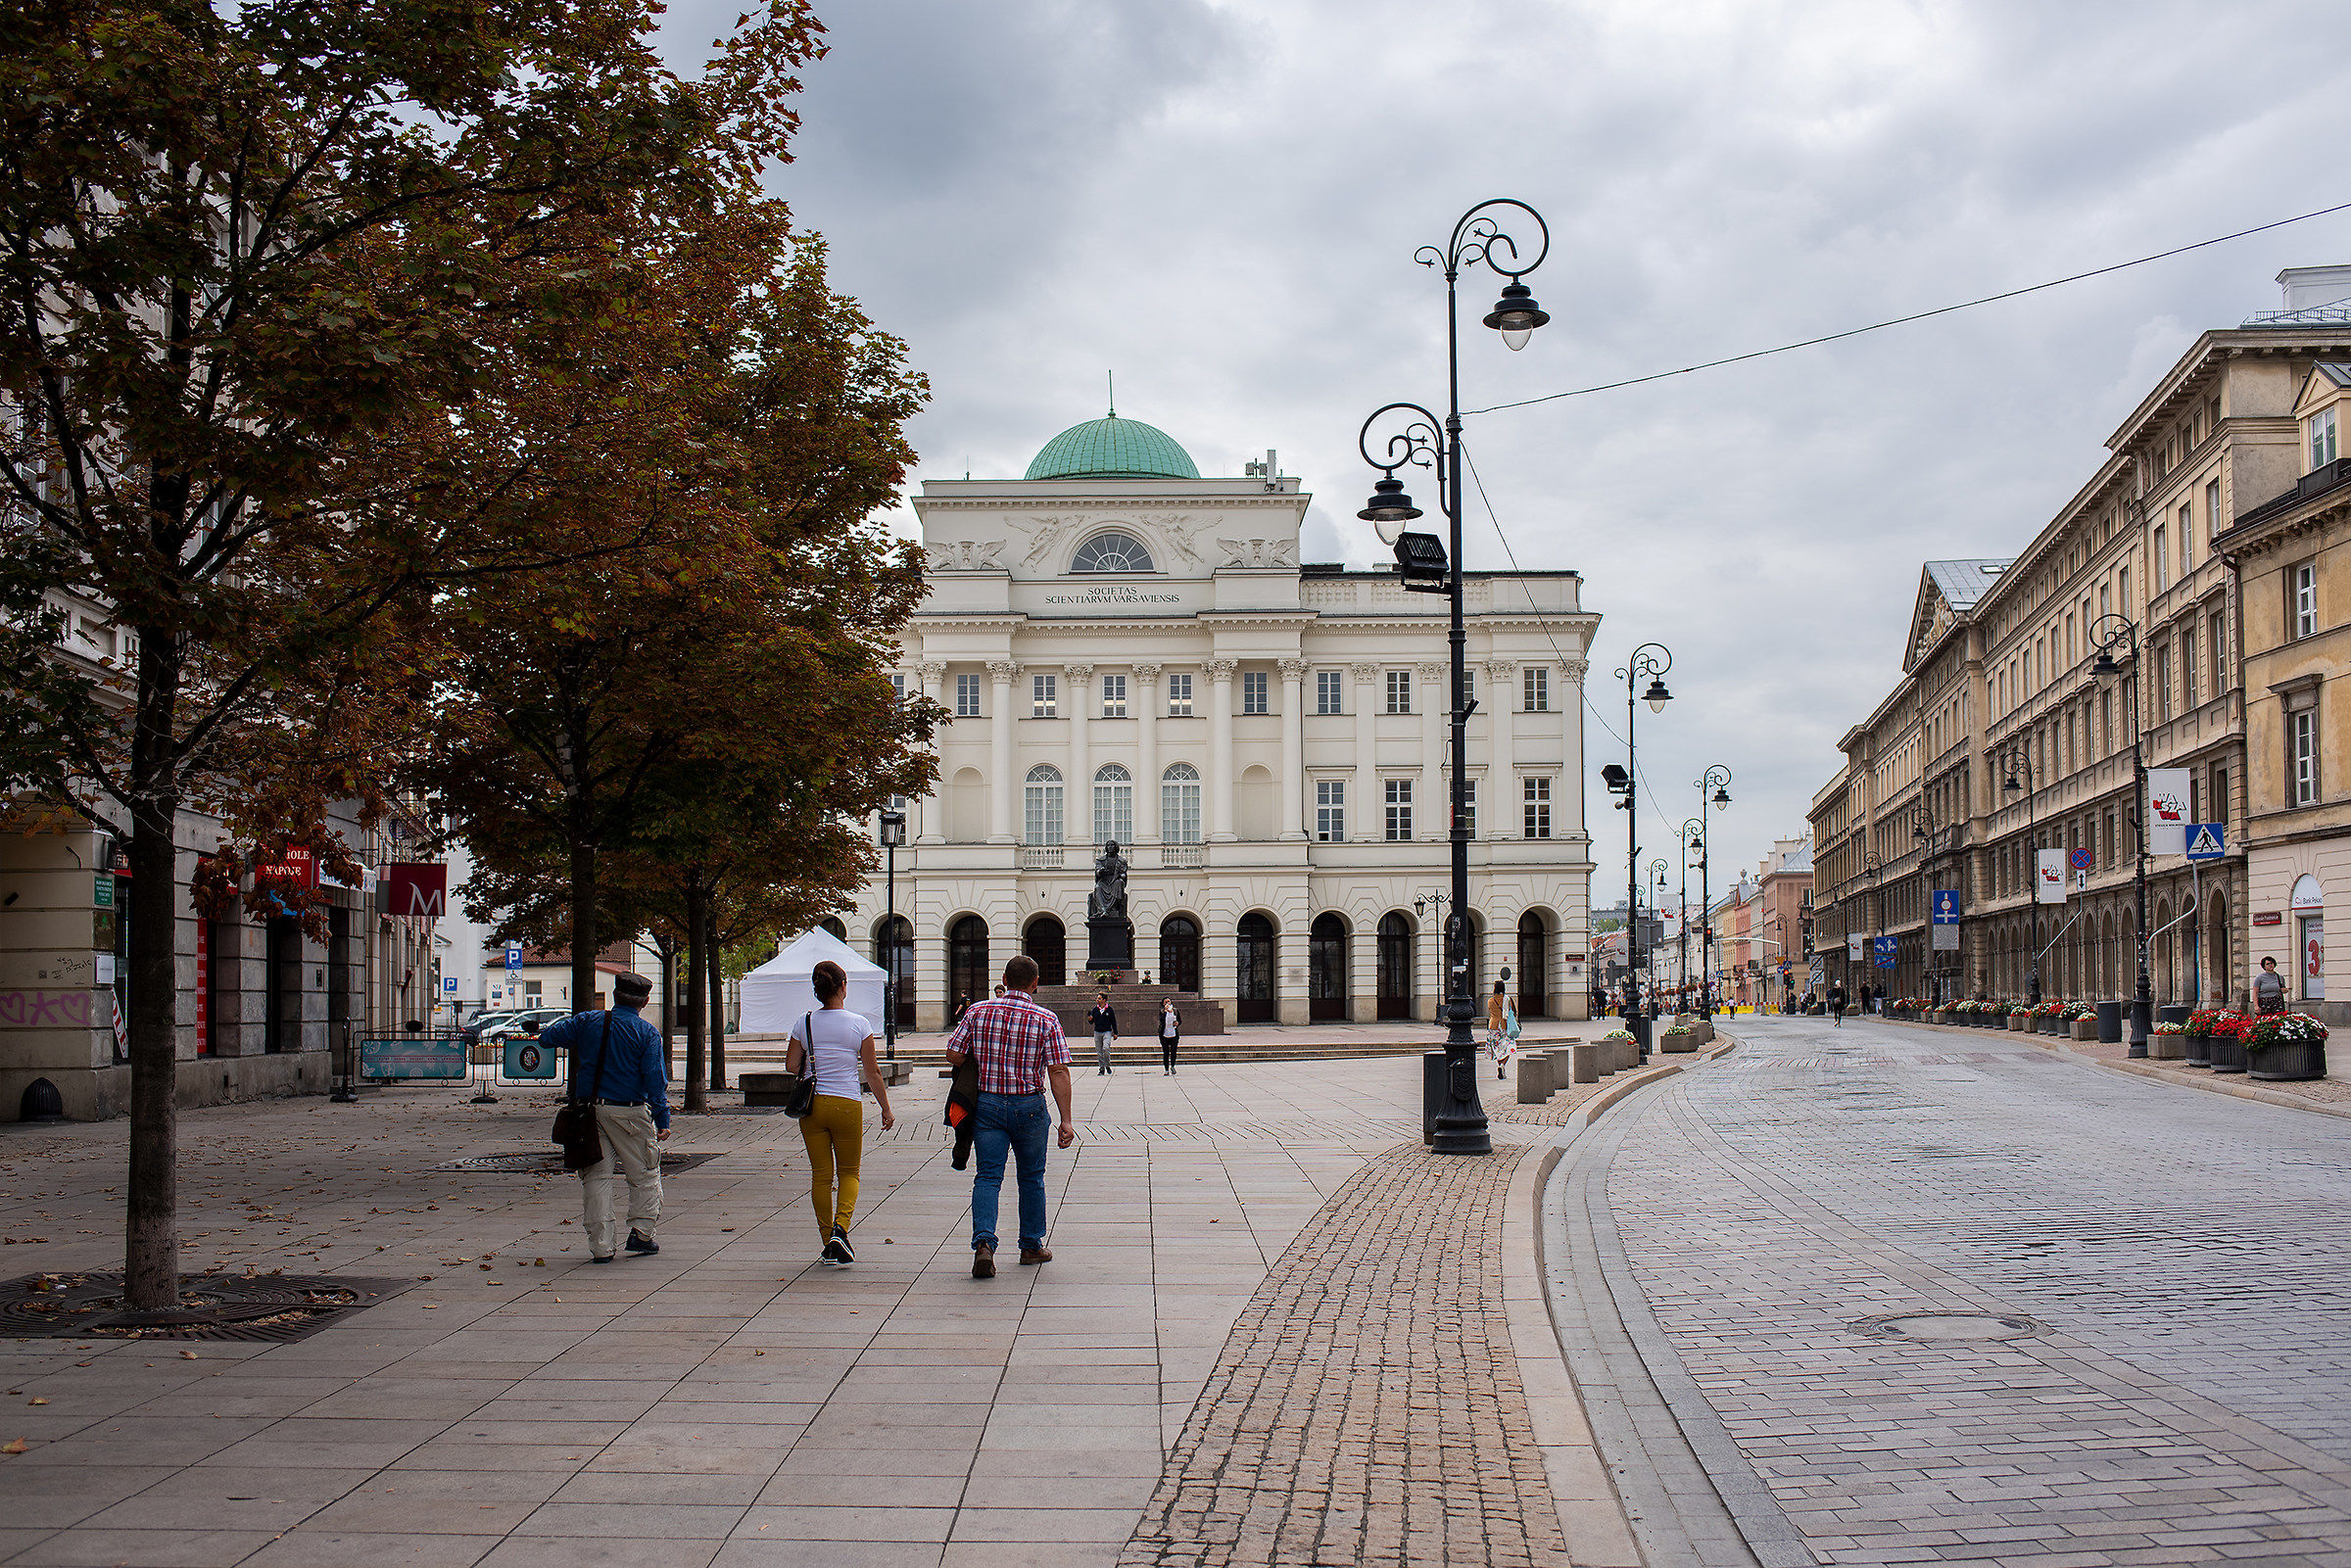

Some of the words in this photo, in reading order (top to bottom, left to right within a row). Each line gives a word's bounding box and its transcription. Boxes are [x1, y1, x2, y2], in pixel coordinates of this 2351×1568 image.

[1087, 587, 1137, 595] SOCIETAS
[1045, 594, 1112, 603] SCIENTIARVM
[265, 865, 302, 876] NAPOJE
[408, 881, 444, 916] M
[508, 950, 519, 964] P
[447, 978, 456, 989] P
